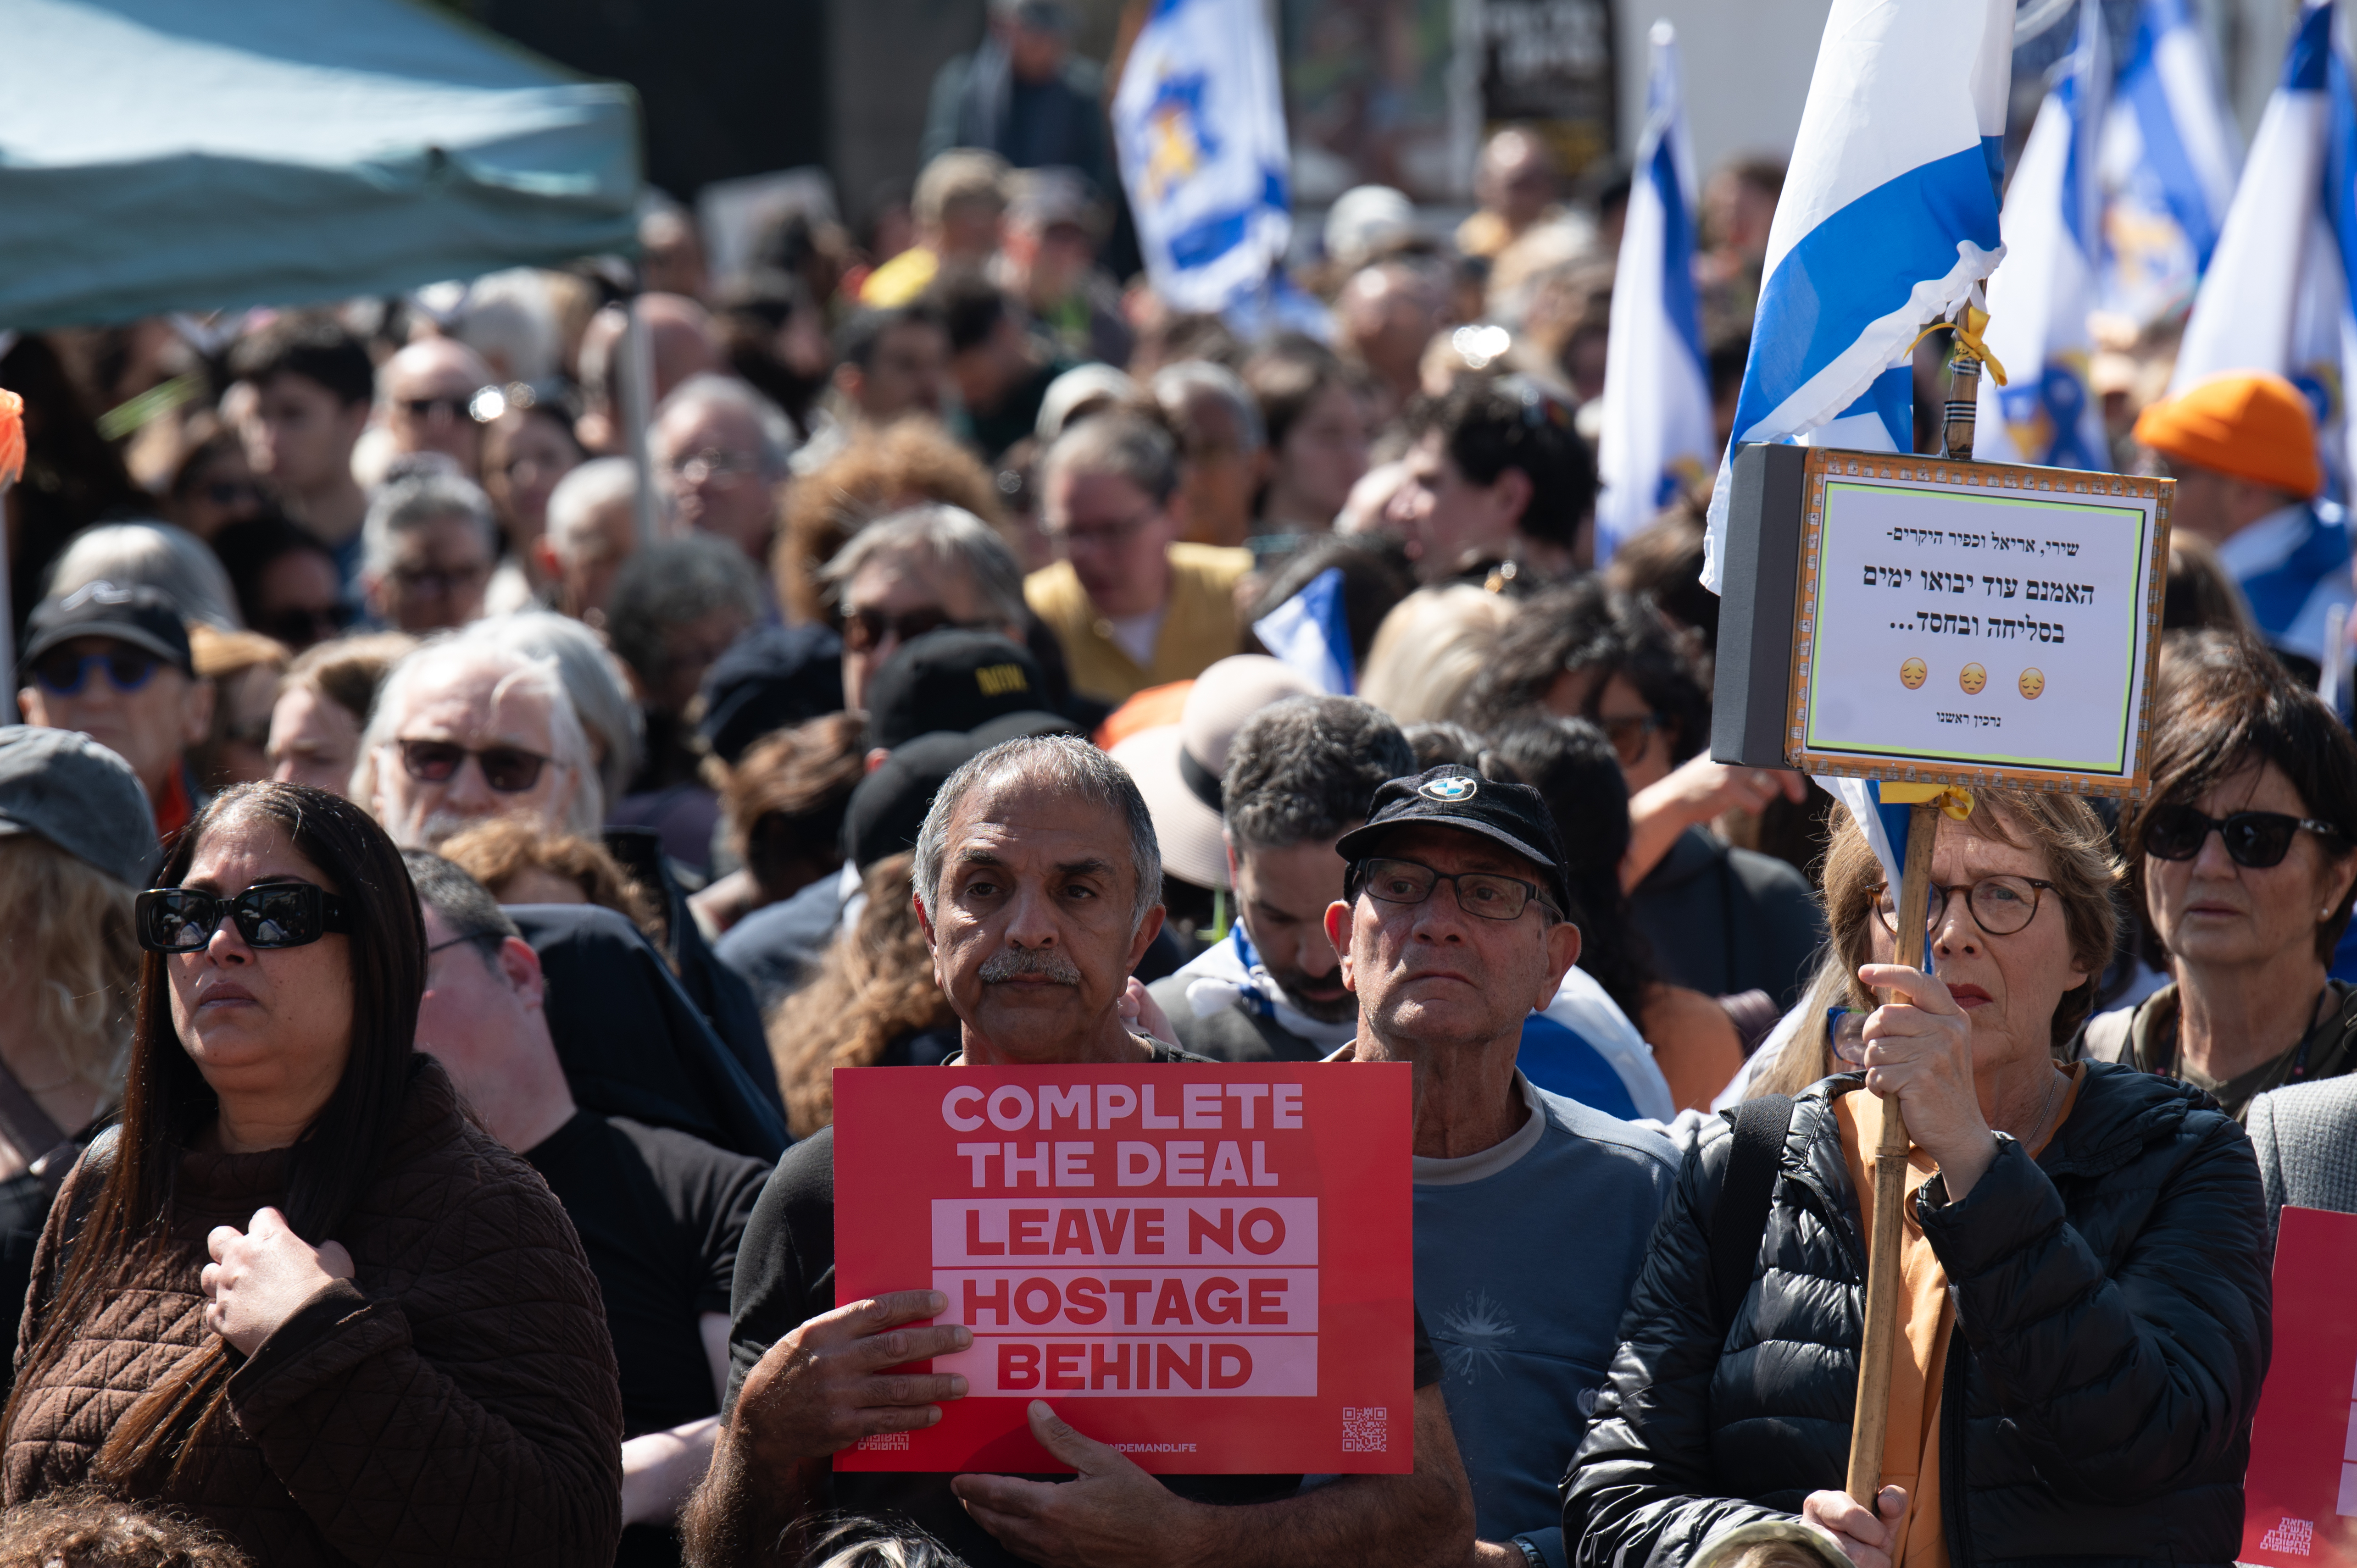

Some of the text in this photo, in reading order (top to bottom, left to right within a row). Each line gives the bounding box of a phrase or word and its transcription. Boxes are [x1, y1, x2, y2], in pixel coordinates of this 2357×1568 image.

[1886, 526, 2080, 557] שירי, אריאל וכפיר היקרים-
[1863, 565, 2095, 605] האמנם עוד יבואו ימים
[1890, 610, 2065, 644] בסליחה ובחסד...
[1936, 711, 2001, 728] נרכין ראשנו
[942, 1083, 1303, 1132] COMPLETE
[957, 1141, 1279, 1188] THE DEAL
[966, 1207, 1286, 1256] LEAVE NO
[962, 1276, 1289, 1325] HOSTAGE
[997, 1343, 1253, 1391] BEHIND
[858, 1442, 909, 1450] והחטופים
[2281, 1516, 2313, 1528] מחאת
[2260, 1541, 2310, 1556] והחטופים
[2263, 1535, 2311, 1549] החטופות
